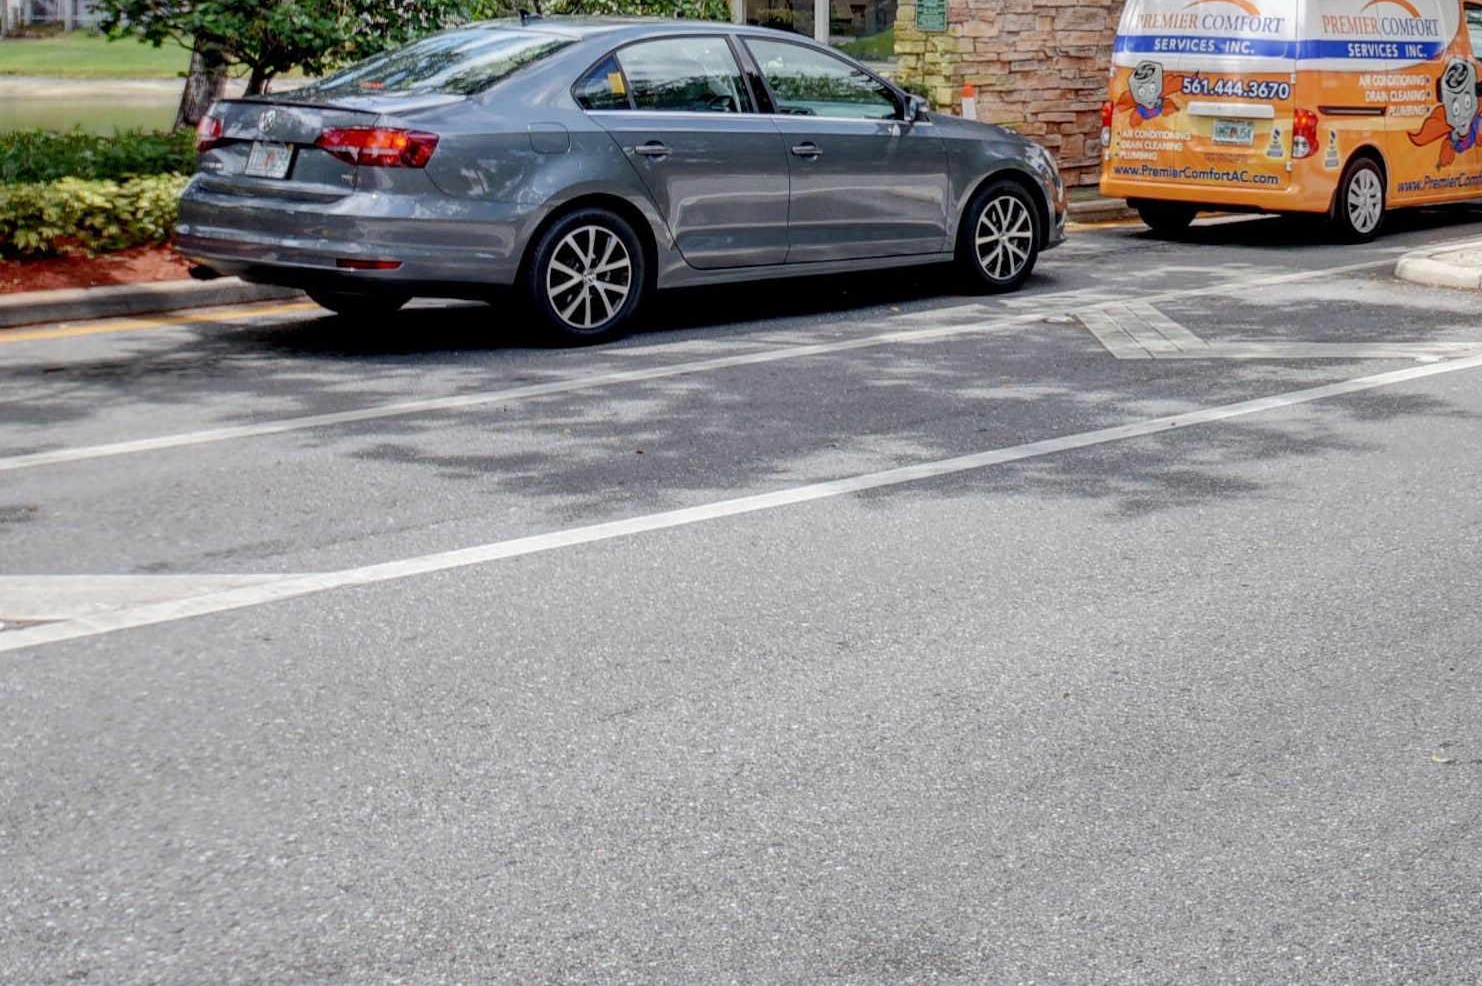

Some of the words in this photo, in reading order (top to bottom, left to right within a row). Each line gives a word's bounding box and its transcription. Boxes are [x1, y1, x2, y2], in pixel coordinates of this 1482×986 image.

[1136, 14, 1198, 30] PREMIER
[1201, 14, 1285, 34] COMFORT
[1322, 15, 1379, 35] PREMIER
[1381, 17, 1439, 37] COMFORT
[1154, 38, 1215, 52] SERVICES
[1225, 41, 1255, 54] INC.
[1347, 43, 1399, 58] SERVICES
[1405, 45, 1428, 58] INC.
[1358, 75, 1373, 87] AIR
[1374, 75, 1425, 87] CONDITIONING
[1182, 78, 1290, 99] 561.444.3670
[1365, 91, 1388, 103] DRAIN
[1390, 91, 1425, 103] CLEANING
[1388, 106, 1425, 118] PLUMBING
[1122, 130, 1134, 140] AIR
[1135, 130, 1192, 141] CONDITIONING
[1120, 140, 1142, 150] DRAIN
[1144, 141, 1184, 152] CLEANING
[1120, 151, 1158, 161] PLUMBING
[1113, 164, 1279, 186] www.PremierComfortAC.com
